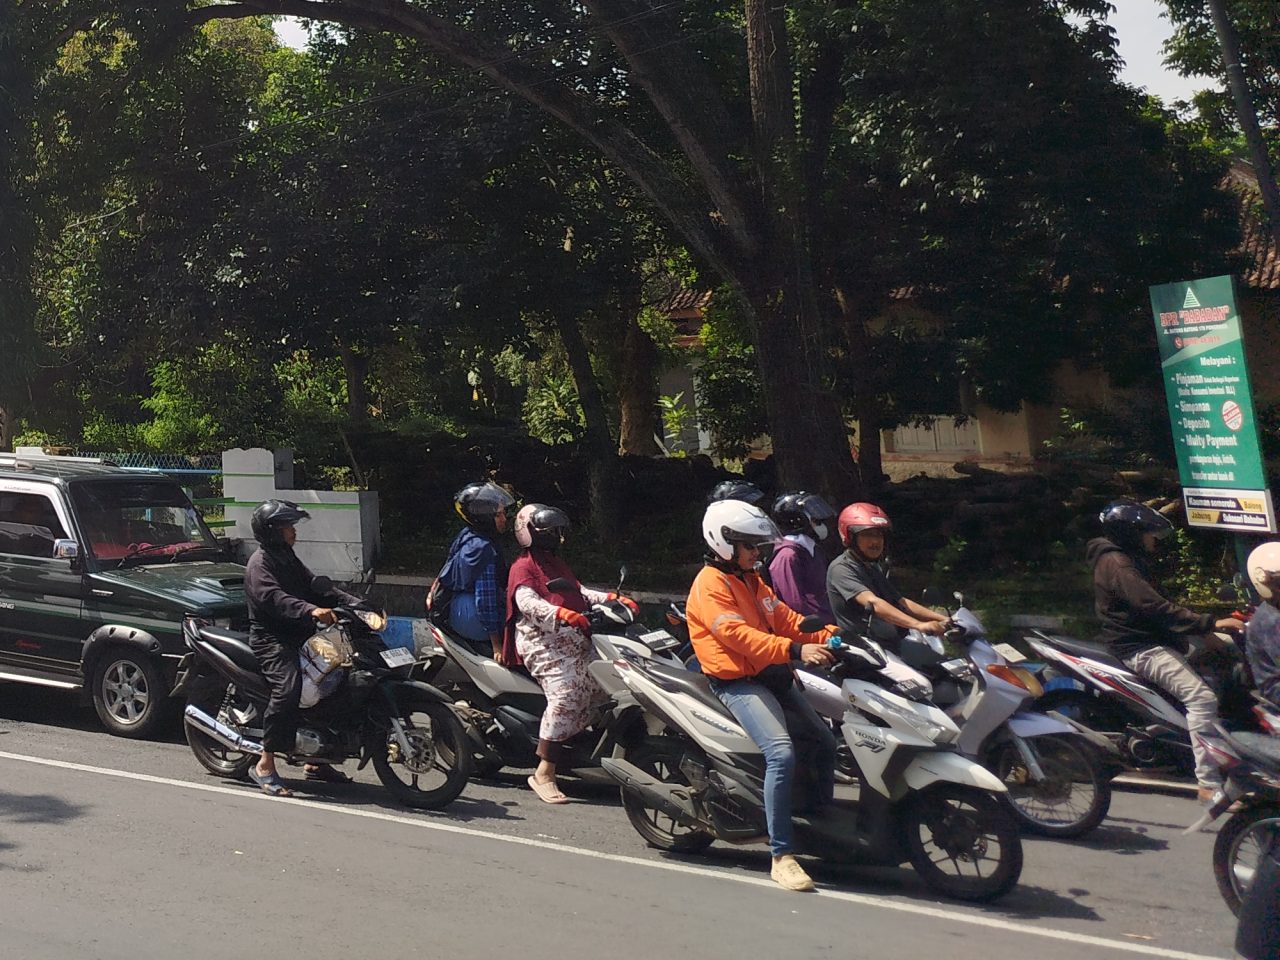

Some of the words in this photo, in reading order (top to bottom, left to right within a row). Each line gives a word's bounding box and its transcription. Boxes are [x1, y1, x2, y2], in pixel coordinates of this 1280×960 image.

[1200, 355, 1232, 367] Melayani
[1175, 373, 1203, 387] Pinjaman
[1180, 400, 1211, 414] Simpanan
[1183, 417, 1211, 431] Deposito
[1206, 433, 1238, 449] Payment
[855, 730, 886, 745] HONDA
